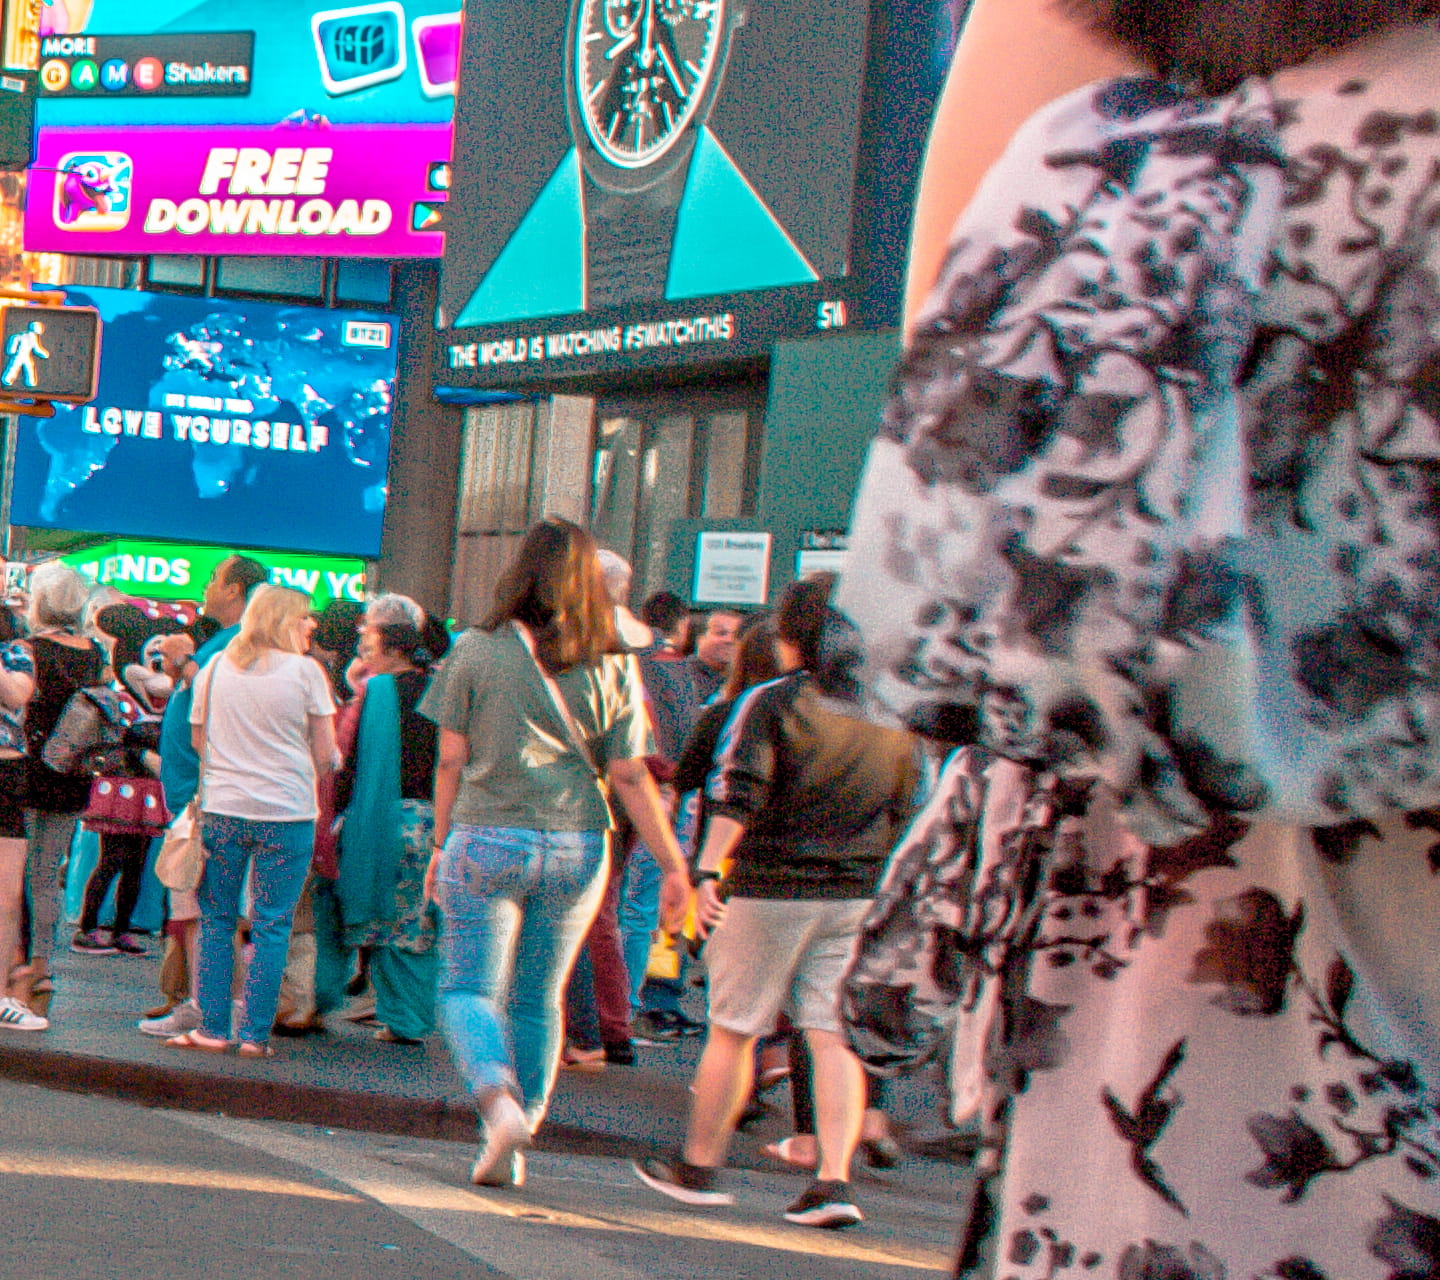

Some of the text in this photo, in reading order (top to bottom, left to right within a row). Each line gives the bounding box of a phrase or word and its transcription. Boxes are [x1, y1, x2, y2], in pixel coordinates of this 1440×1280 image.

[41, 37, 96, 56] MORE
[199, 147, 333, 196] FREE
[143, 198, 393, 237] DOWNLOAD
[449, 313, 735, 368] THE WORLD IS WATCHING #SWATCHTHIS
[82, 406, 330, 453] LOVE YOURSELF
